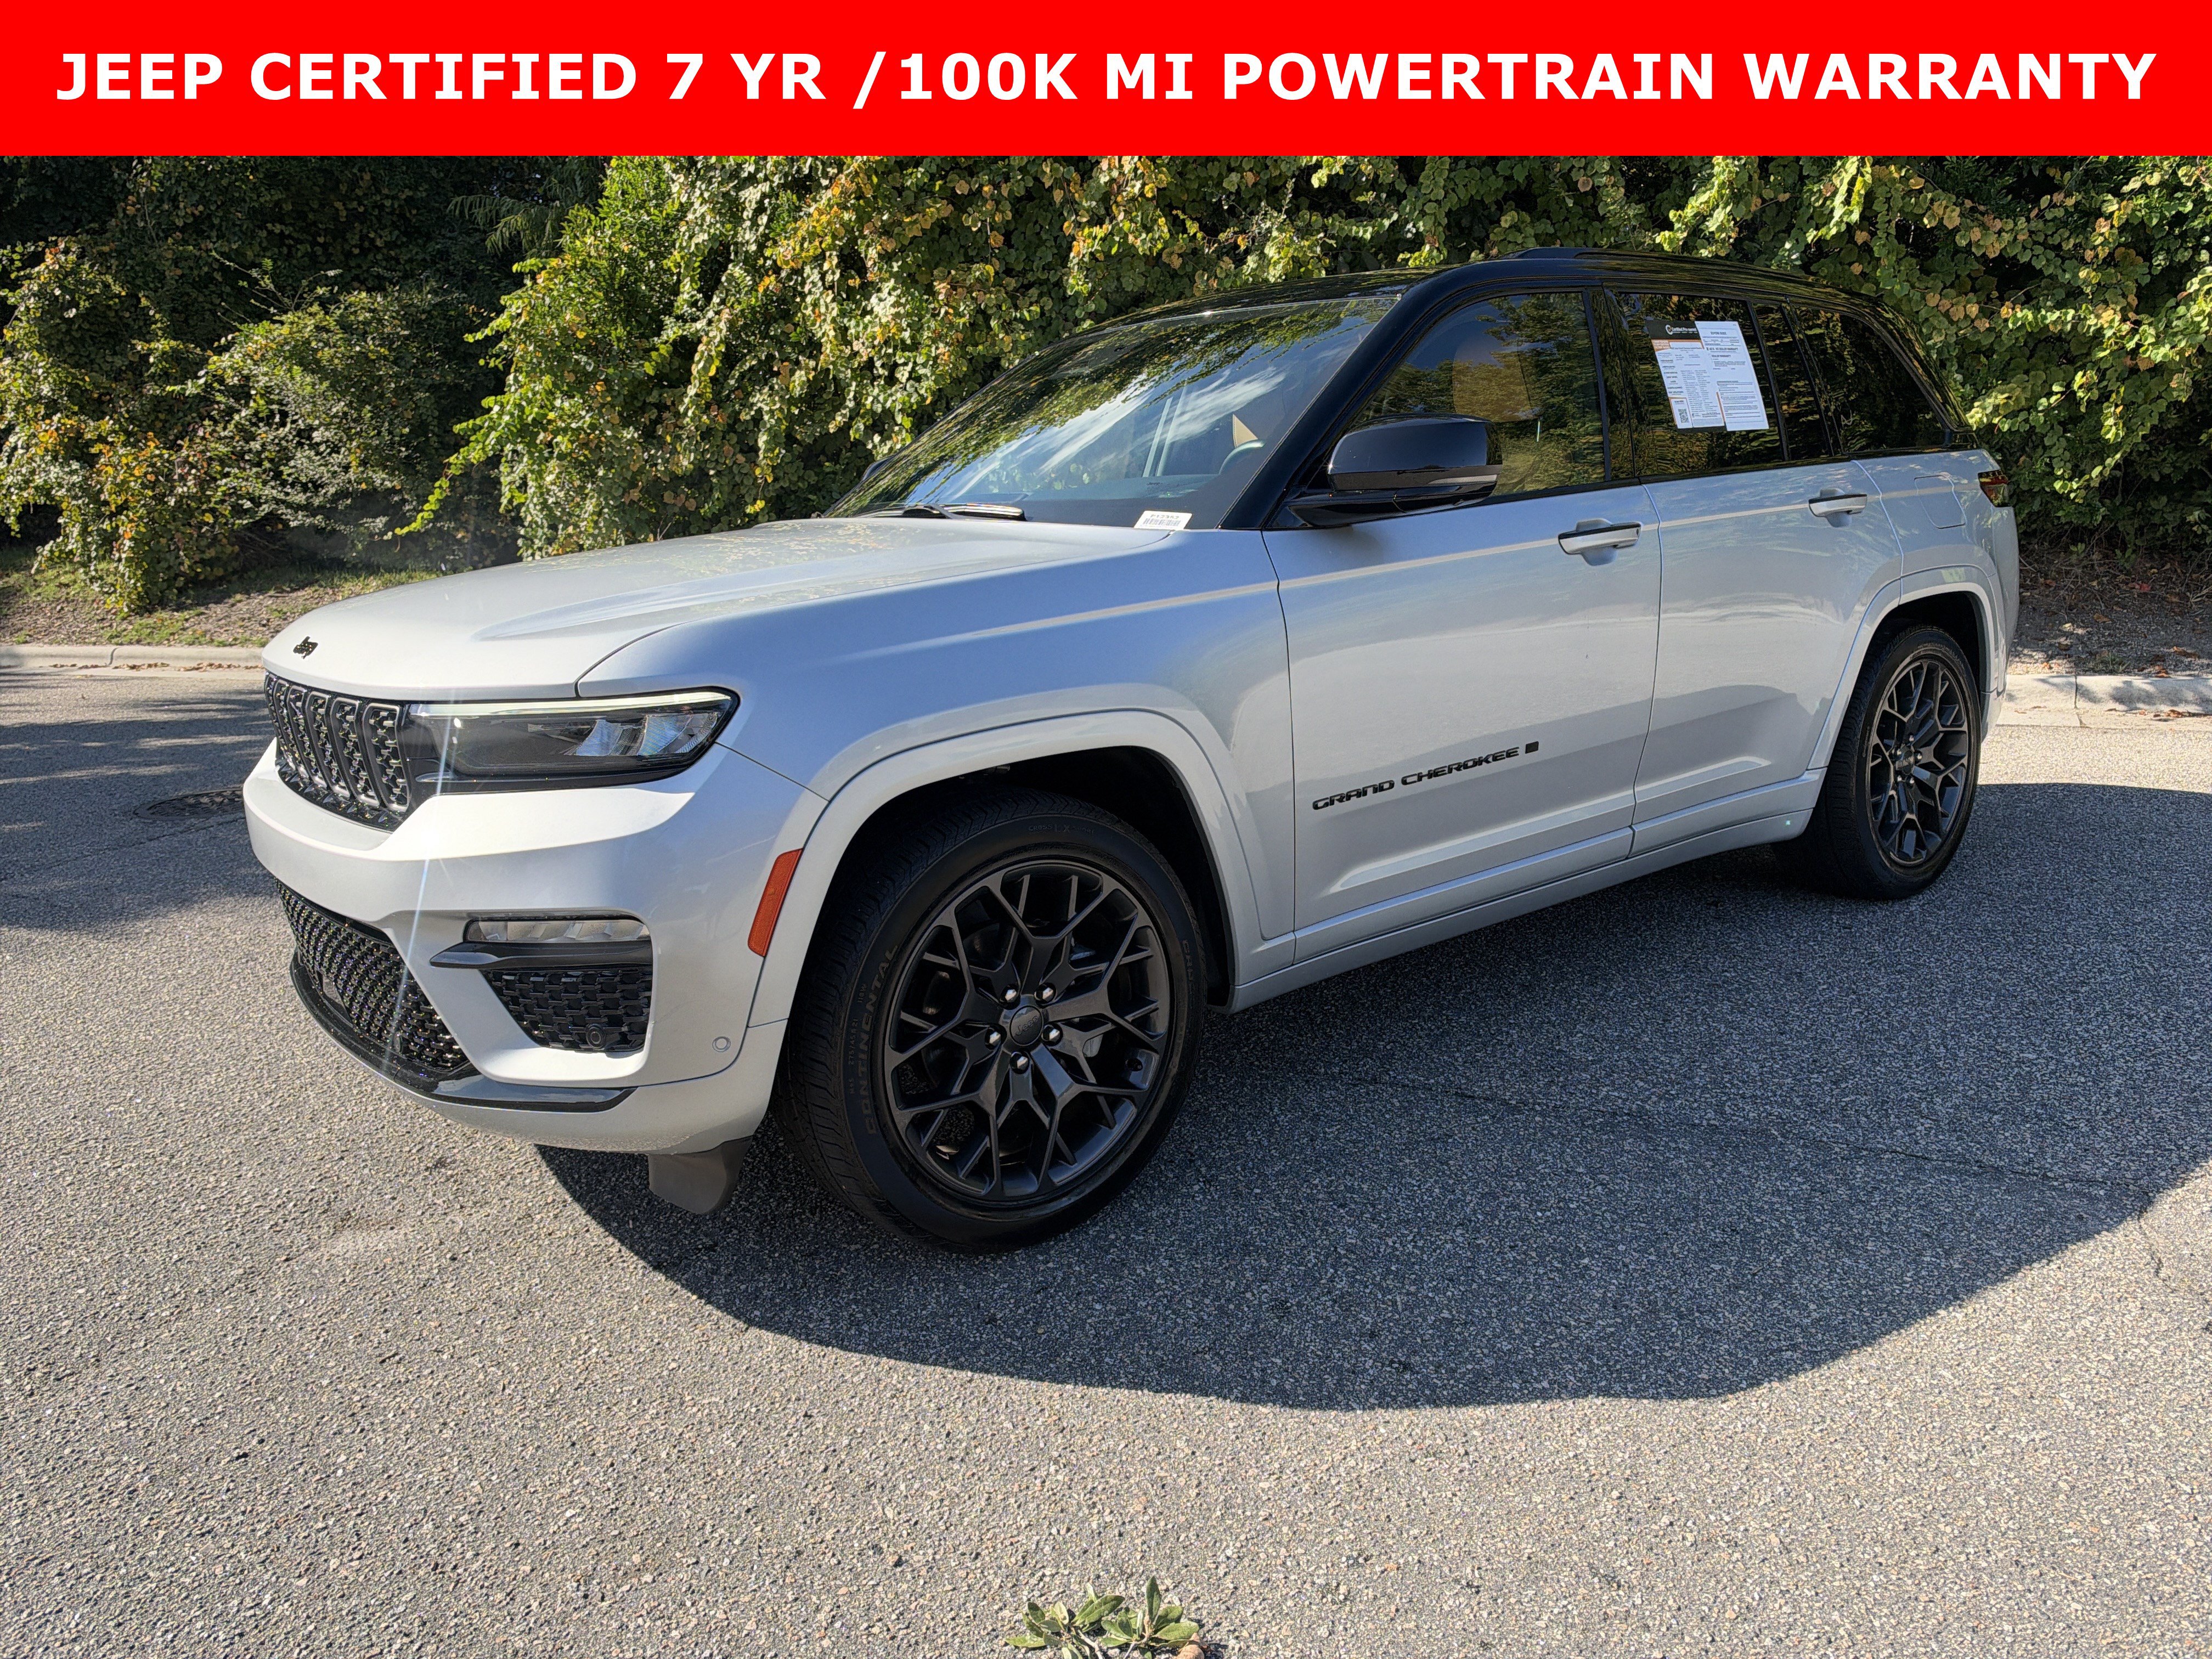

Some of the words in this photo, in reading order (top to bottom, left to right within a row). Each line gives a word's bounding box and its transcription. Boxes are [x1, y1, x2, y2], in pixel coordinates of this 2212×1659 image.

[1312, 779, 1395, 810] GRAND
[1401, 746, 1520, 786] CHEROKEE
[857, 944, 899, 1135] CONTINENTAL
[1015, 1015, 1039, 1036] Jeep
